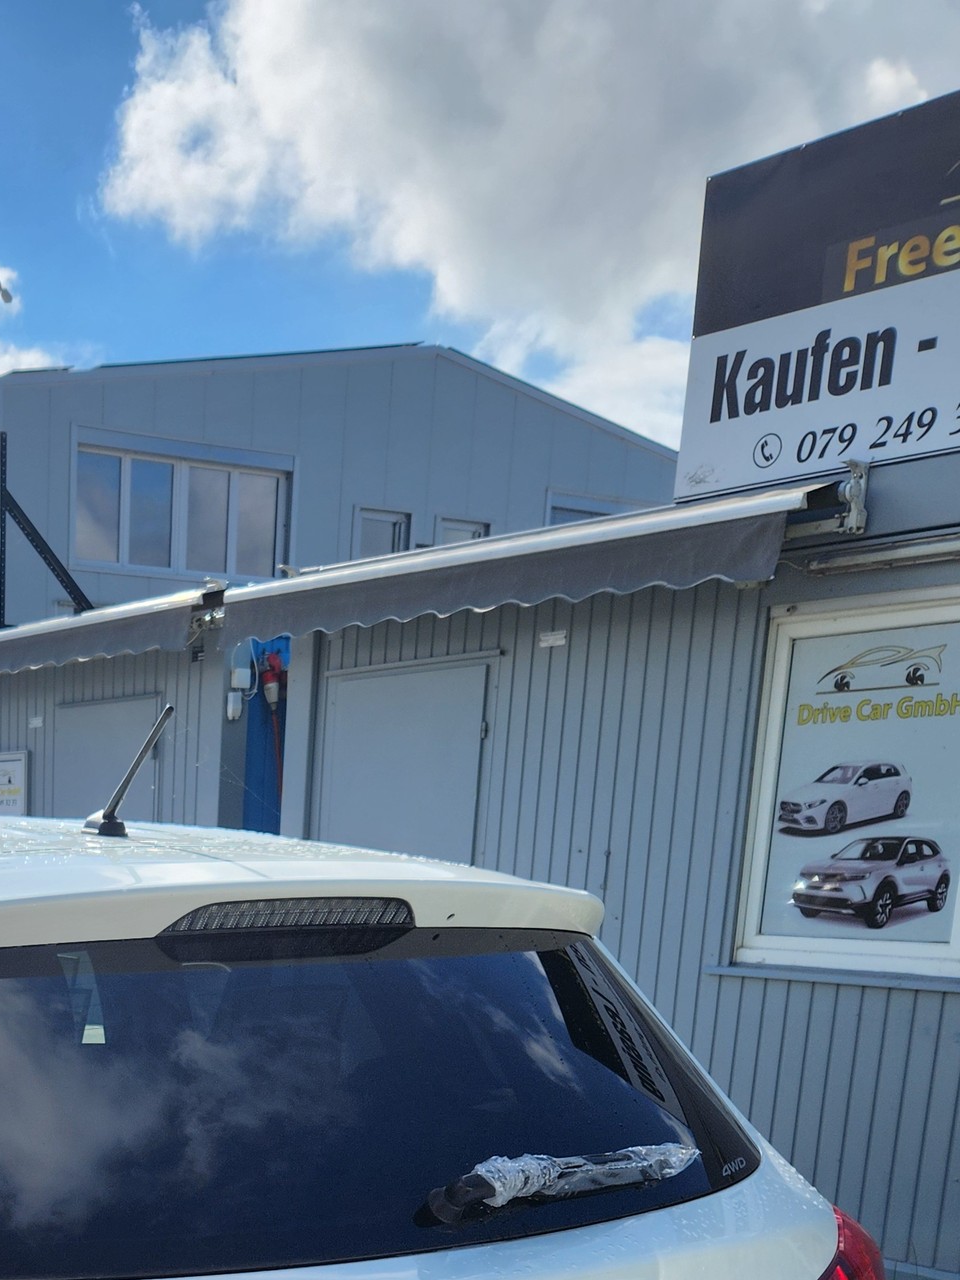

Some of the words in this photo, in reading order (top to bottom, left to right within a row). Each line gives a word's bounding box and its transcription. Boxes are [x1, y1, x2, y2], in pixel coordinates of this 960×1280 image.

[843, 224, 960, 293] Free
[709, 326, 898, 424] Kaufen
[796, 422, 858, 463] 079
[869, 406, 938, 450] 249
[797, 701, 852, 726] Drive
[856, 699, 893, 721] Car
[896, 693, 960, 719] GmbH
[722, 1157, 746, 1177] 4WD
